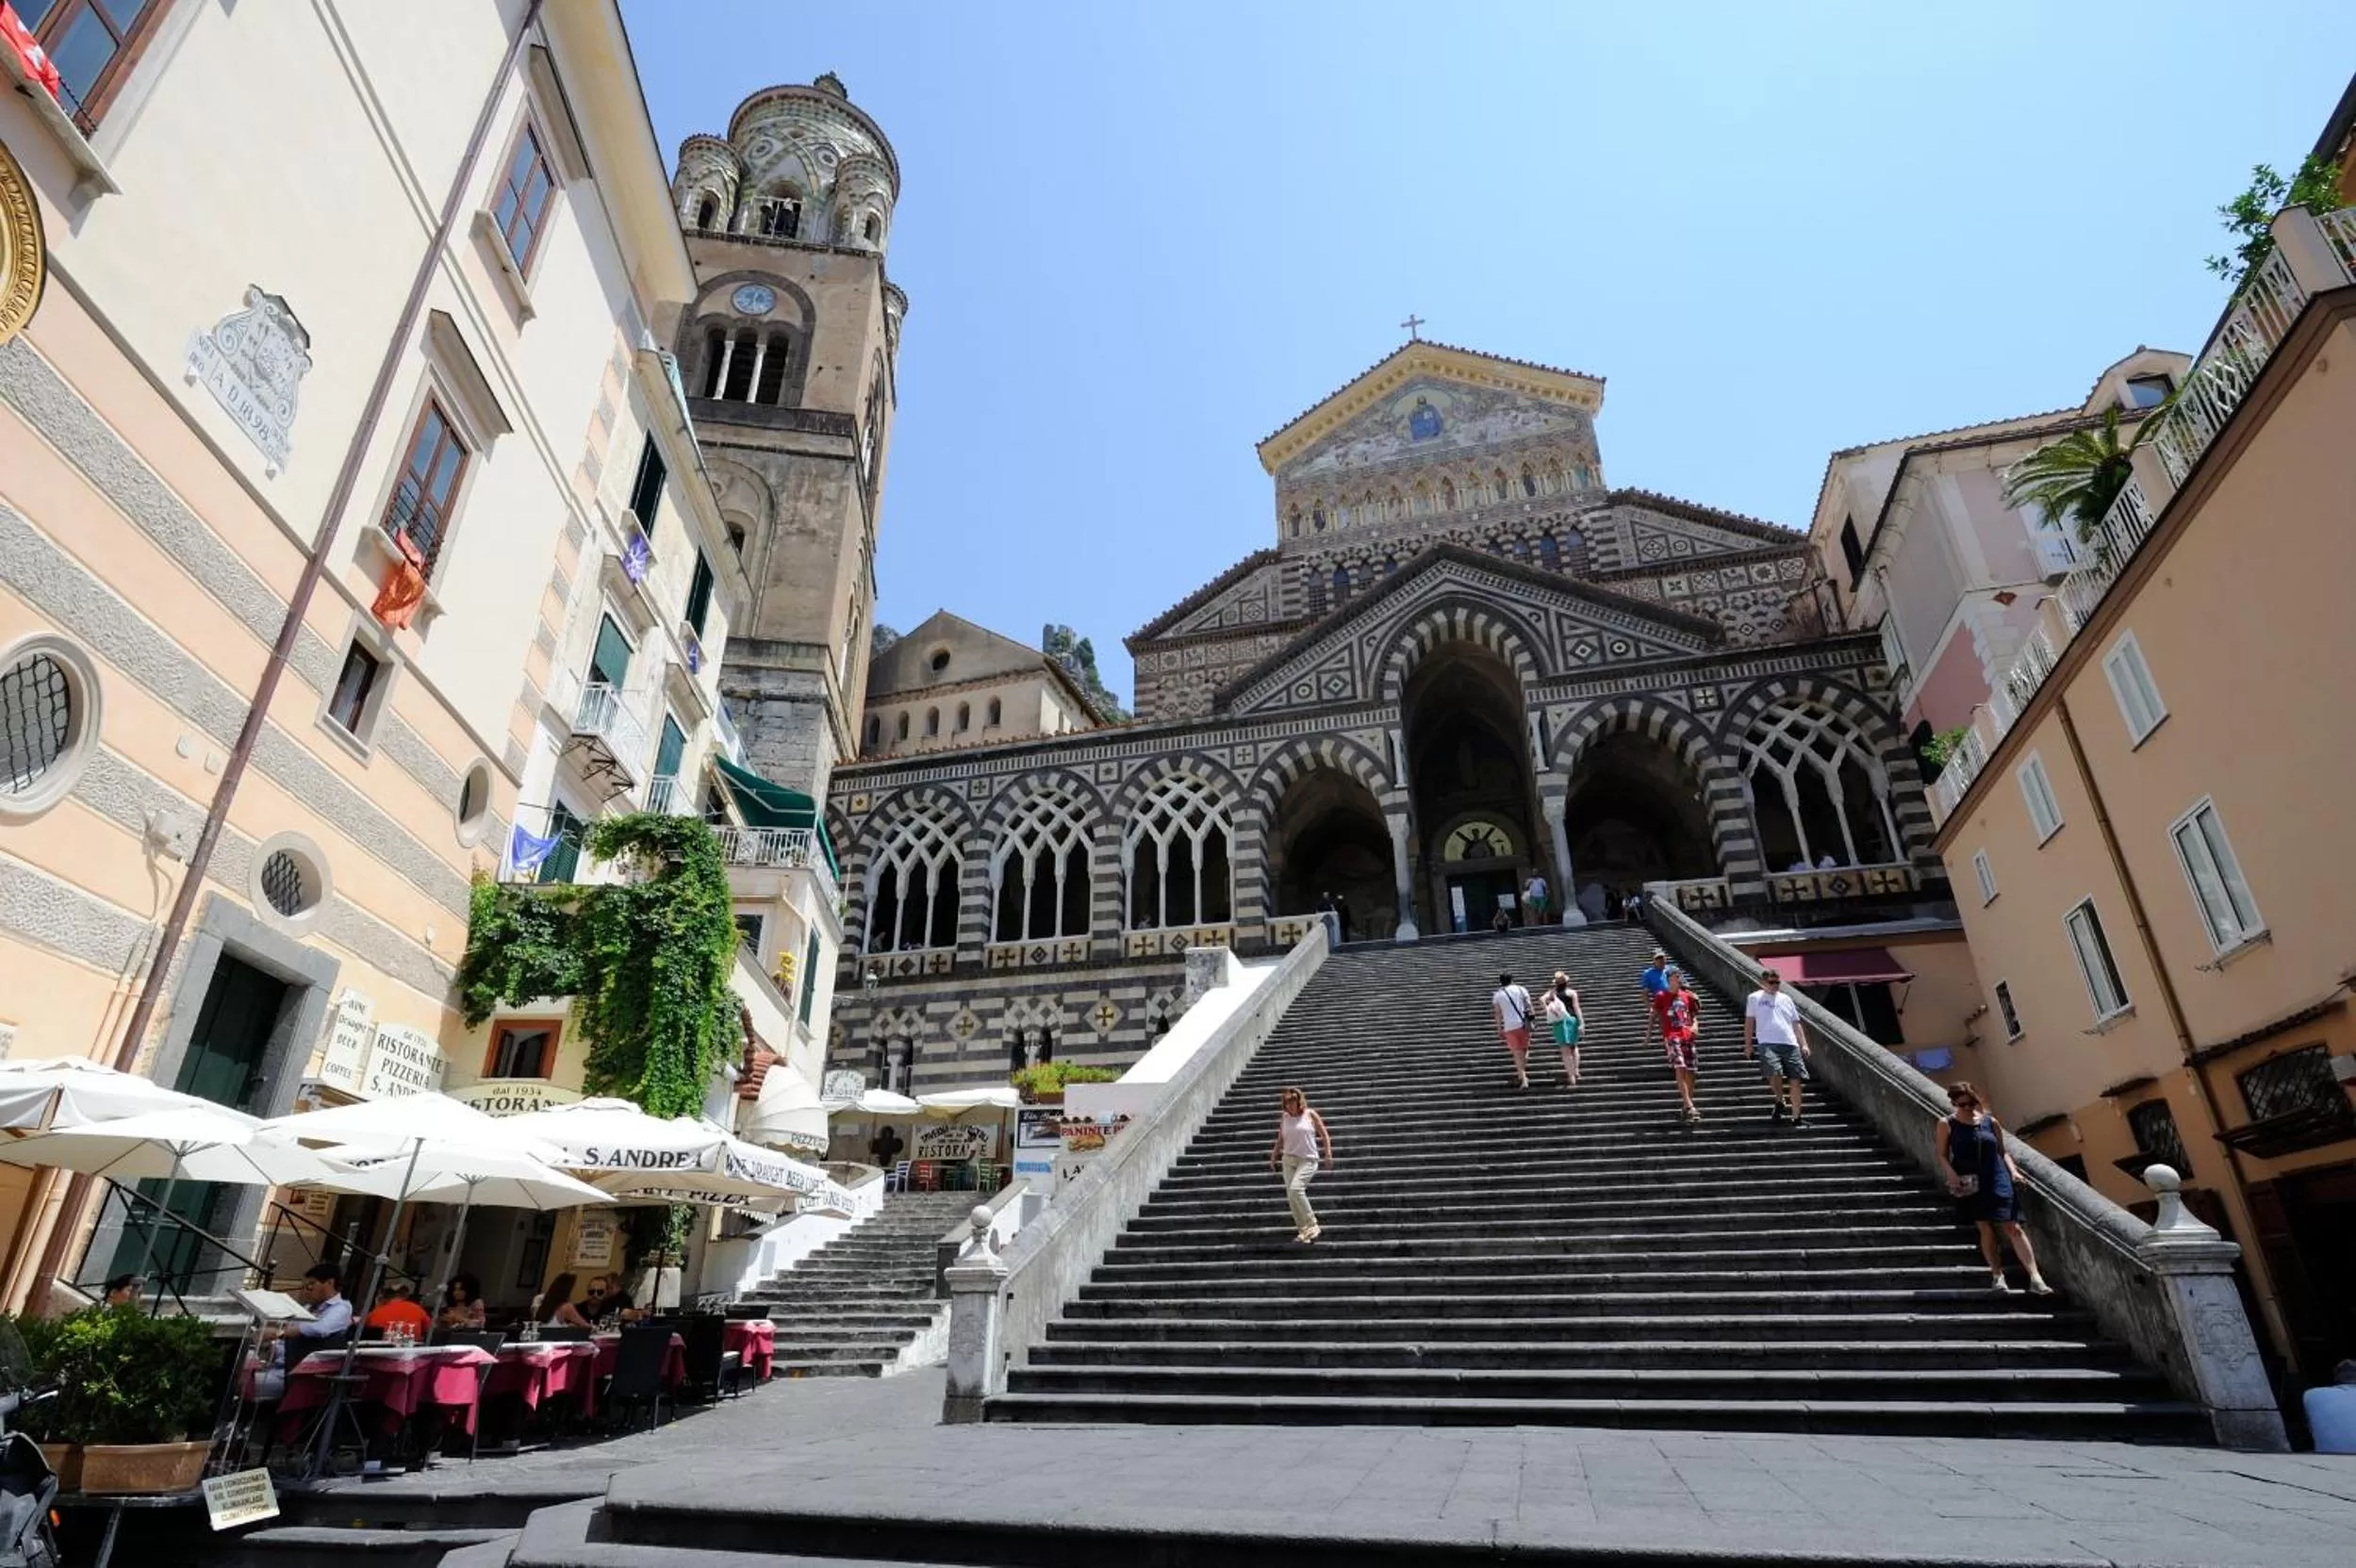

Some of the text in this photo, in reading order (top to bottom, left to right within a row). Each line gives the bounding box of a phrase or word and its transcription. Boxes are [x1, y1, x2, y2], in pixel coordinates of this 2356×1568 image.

[377, 1032, 444, 1074] RISTORANTE
[381, 1058, 430, 1089] PIZZERIA
[371, 1075, 382, 1093] S.
[492, 1086, 510, 1096] dal
[1062, 1125, 1101, 1136] PANINI
[917, 1144, 987, 1159] RISTORAE
